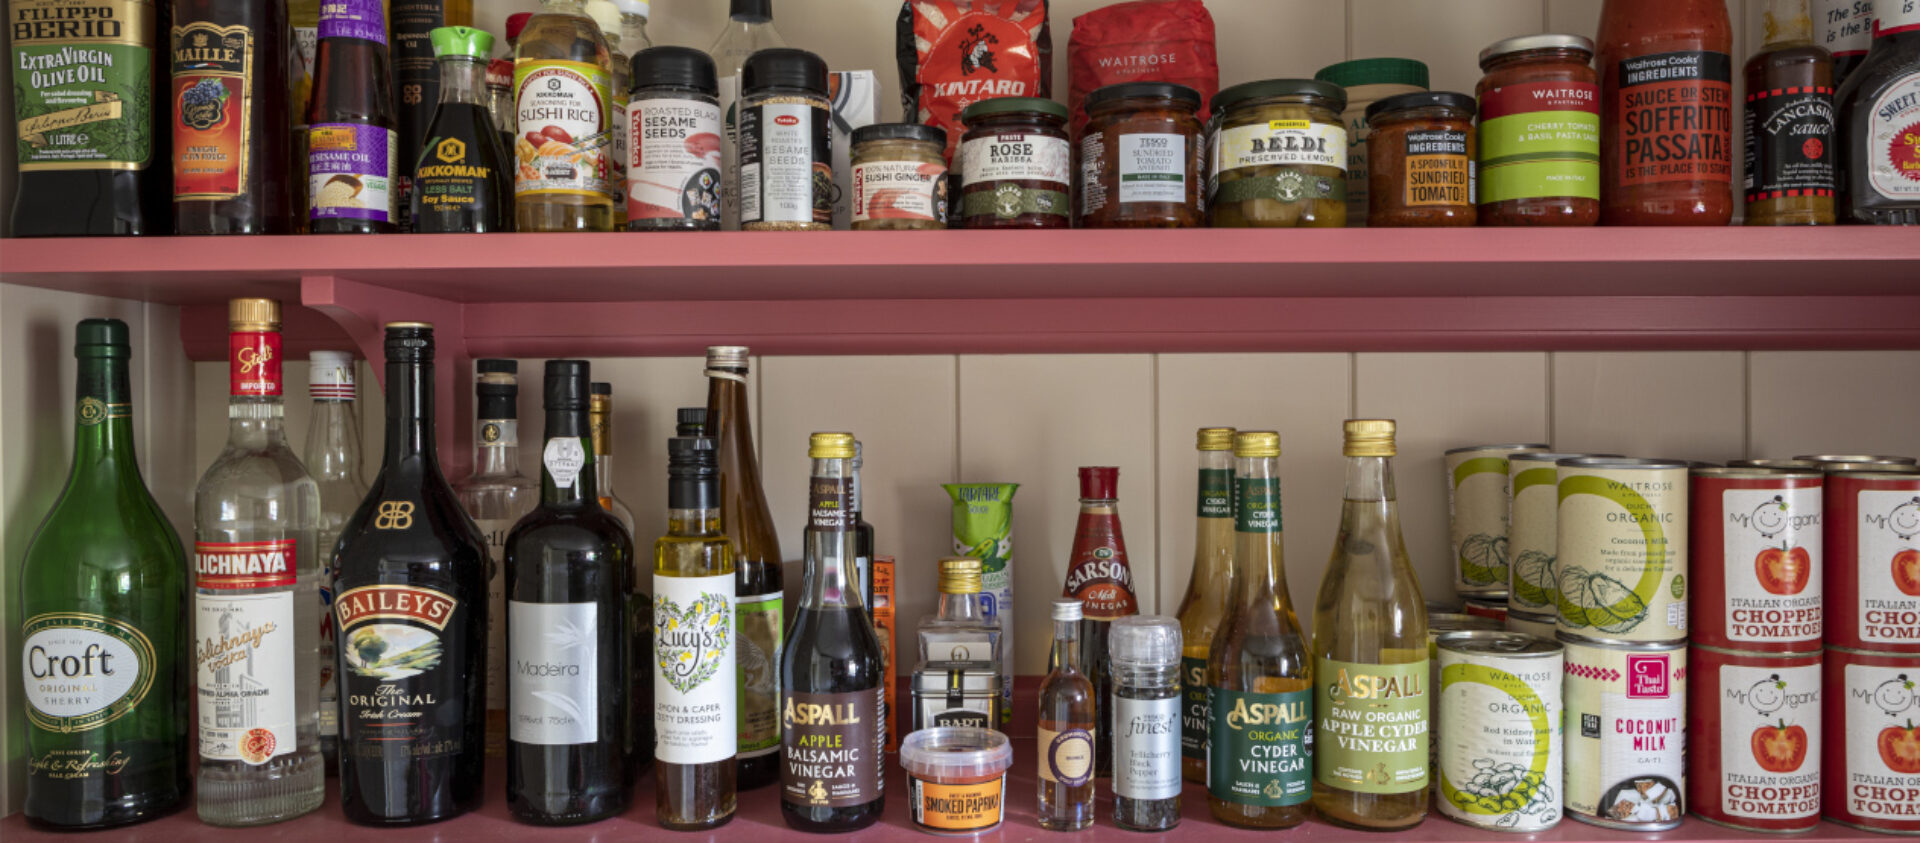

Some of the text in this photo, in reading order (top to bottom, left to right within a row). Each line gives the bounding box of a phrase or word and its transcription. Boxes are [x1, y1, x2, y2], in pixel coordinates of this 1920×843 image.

[19, 6, 114, 21] FILIPPO
[1826, 9, 1850, 25] The
[14, 20, 121, 40] BERIO
[1826, 30, 1837, 44] is
[1840, 21, 1861, 37] the
[20, 47, 113, 70] EXTRA VIRGIN
[174, 48, 237, 63] MAILLE
[1098, 53, 1177, 69] WAITROSE
[1625, 57, 1667, 73] Waitrose
[31, 65, 106, 89] OLIVE OIL
[1627, 64, 1699, 85] INGREDIENTS
[1532, 89, 1593, 101] WAITROSE
[1625, 87, 1676, 110] SAUCE
[1681, 87, 1699, 99] OR
[645, 107, 692, 118] ROASTED
[1878, 93, 1917, 122] SWEET
[519, 107, 597, 124] SUSHI RICE
[645, 116, 698, 129] SESAME
[1625, 105, 1730, 137] SOFFRITTO
[645, 128, 687, 139] SEEDS
[1527, 122, 1596, 132] CHERRY TOMATO
[1788, 123, 1829, 137] sauce
[56, 134, 76, 145] LITRE
[632, 112, 642, 166] Yutaka
[1408, 132, 1444, 142] Waitrose
[1528, 131, 1582, 142] BASIL PASTA
[764, 146, 810, 156] SESAME
[989, 143, 1034, 157] ROSE
[1250, 136, 1327, 155] BELDI
[1409, 142, 1466, 153] INGREDIENTS
[1625, 135, 1723, 167] PASSATA
[352, 153, 371, 163] OIL
[768, 156, 806, 165] SEEDS
[991, 156, 1033, 164] HARISSA
[1135, 157, 1172, 165] TOMATO
[1239, 153, 1335, 165] PRESERVED LEMONS
[1410, 159, 1456, 170] A SPOONFUL
[416, 164, 488, 179] KIKKOMAN
[865, 172, 933, 183] SUSHI GINGER
[1625, 162, 1709, 179] IS THE PLACE TO
[1410, 171, 1465, 185] SUNDRIED
[425, 185, 473, 194] LESS SALT
[1410, 186, 1460, 201] TOMATO
[422, 193, 476, 205] Soy Sauce
[240, 382, 276, 391] IMPORTED
[1607, 481, 1673, 492] WAITROSE
[957, 486, 1002, 503] TARTARE
[1205, 497, 1227, 505] CYDER
[818, 500, 840, 509] APPLE
[967, 504, 990, 515] Sauce
[1202, 506, 1231, 514] VINEGAR
[1626, 502, 1656, 510] DUCHY
[812, 508, 848, 518] BALSAMIC
[1252, 511, 1276, 519] CYDER
[1605, 512, 1673, 524] ORGANIC
[813, 518, 845, 527] VINEGAR
[1248, 519, 1279, 528] VINEGAR
[1729, 512, 1753, 529] Mr
[1865, 512, 1889, 530] Mr
[1610, 537, 1648, 546] Coconut
[340, 590, 450, 622] BAILEYS
[1730, 596, 1821, 609] ITALIAN ORGANIC
[1864, 599, 1917, 610] ITALIAN
[1731, 607, 1821, 625] CHOPPED
[1731, 621, 1821, 638] TOMATOES
[656, 614, 714, 677] Lucy's
[28, 643, 114, 679] Croft
[208, 650, 248, 675] vodka
[516, 660, 581, 685] Madeira
[1489, 671, 1552, 683] WAITROSE
[1328, 667, 1424, 706] ASPALL
[1635, 674, 1661, 686] Thai
[39, 683, 99, 694] ORIGINAL
[240, 688, 270, 698] GRADE
[374, 683, 405, 696] The
[1634, 684, 1665, 695] Taste
[1852, 686, 1874, 705] Mr
[43, 696, 92, 707] SHERRY
[349, 693, 437, 708] ORIGINAL
[1726, 688, 1749, 705] Mr
[359, 709, 424, 720] Irish Cream
[682, 702, 721, 714] & CAPER
[783, 696, 861, 731] ASPALL
[1226, 697, 1308, 731] ASPALL
[1331, 706, 1422, 723] RAW ORGANIC
[1487, 702, 1552, 714] ORGANIC
[677, 713, 722, 725] DRESSING
[1124, 713, 1177, 738] finest
[1321, 717, 1428, 739] APPLE CYDER
[1483, 726, 1533, 738] Red Kidney
[1615, 718, 1677, 735] COCONUT
[798, 734, 844, 749] APPLE
[1248, 728, 1300, 743] ORGANIC
[1503, 737, 1541, 746] in Water
[1250, 743, 1299, 759] CYDER
[1336, 735, 1418, 754] VINEGAR
[1633, 736, 1666, 752] MILK
[787, 745, 861, 764] BALSAMIC
[789, 762, 857, 779] VINEGAR
[1130, 759, 1153, 768] Black
[1238, 757, 1305, 774] VINEGAR
[1129, 767, 1159, 777] Pepper
[1727, 771, 1819, 786] ITALIAN ORGANIC
[1852, 773, 1904, 787] ITALIAN
[1727, 784, 1819, 802] CHOPPED
[1853, 784, 1920, 803] CHOP
[925, 795, 964, 815] SMOKED
[965, 792, 1000, 814] PAPRIKA
[1727, 798, 1819, 816] TOMATOES
